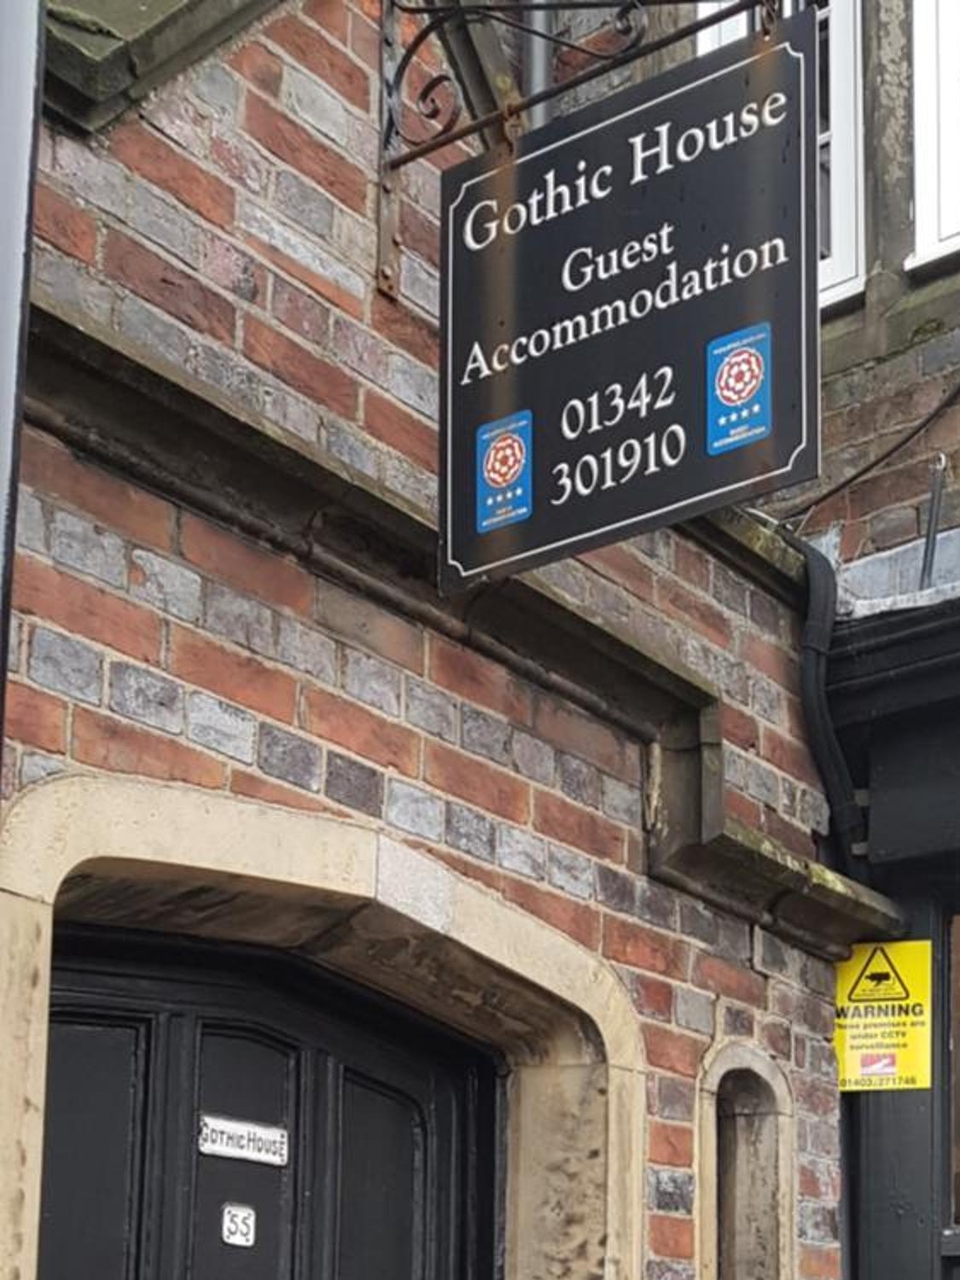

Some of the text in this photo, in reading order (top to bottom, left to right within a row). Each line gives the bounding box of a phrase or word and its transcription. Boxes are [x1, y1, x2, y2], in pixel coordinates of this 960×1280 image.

[462, 90, 788, 253] Gothic House
[561, 220, 675, 293] Guest
[460, 236, 789, 387] Accommodation
[560, 365, 677, 441] 01342
[550, 424, 687, 506] 301910
[836, 1002, 925, 1019] WARNING
[862, 1020, 907, 1030] premises
[227, 1213, 251, 1237] 55
